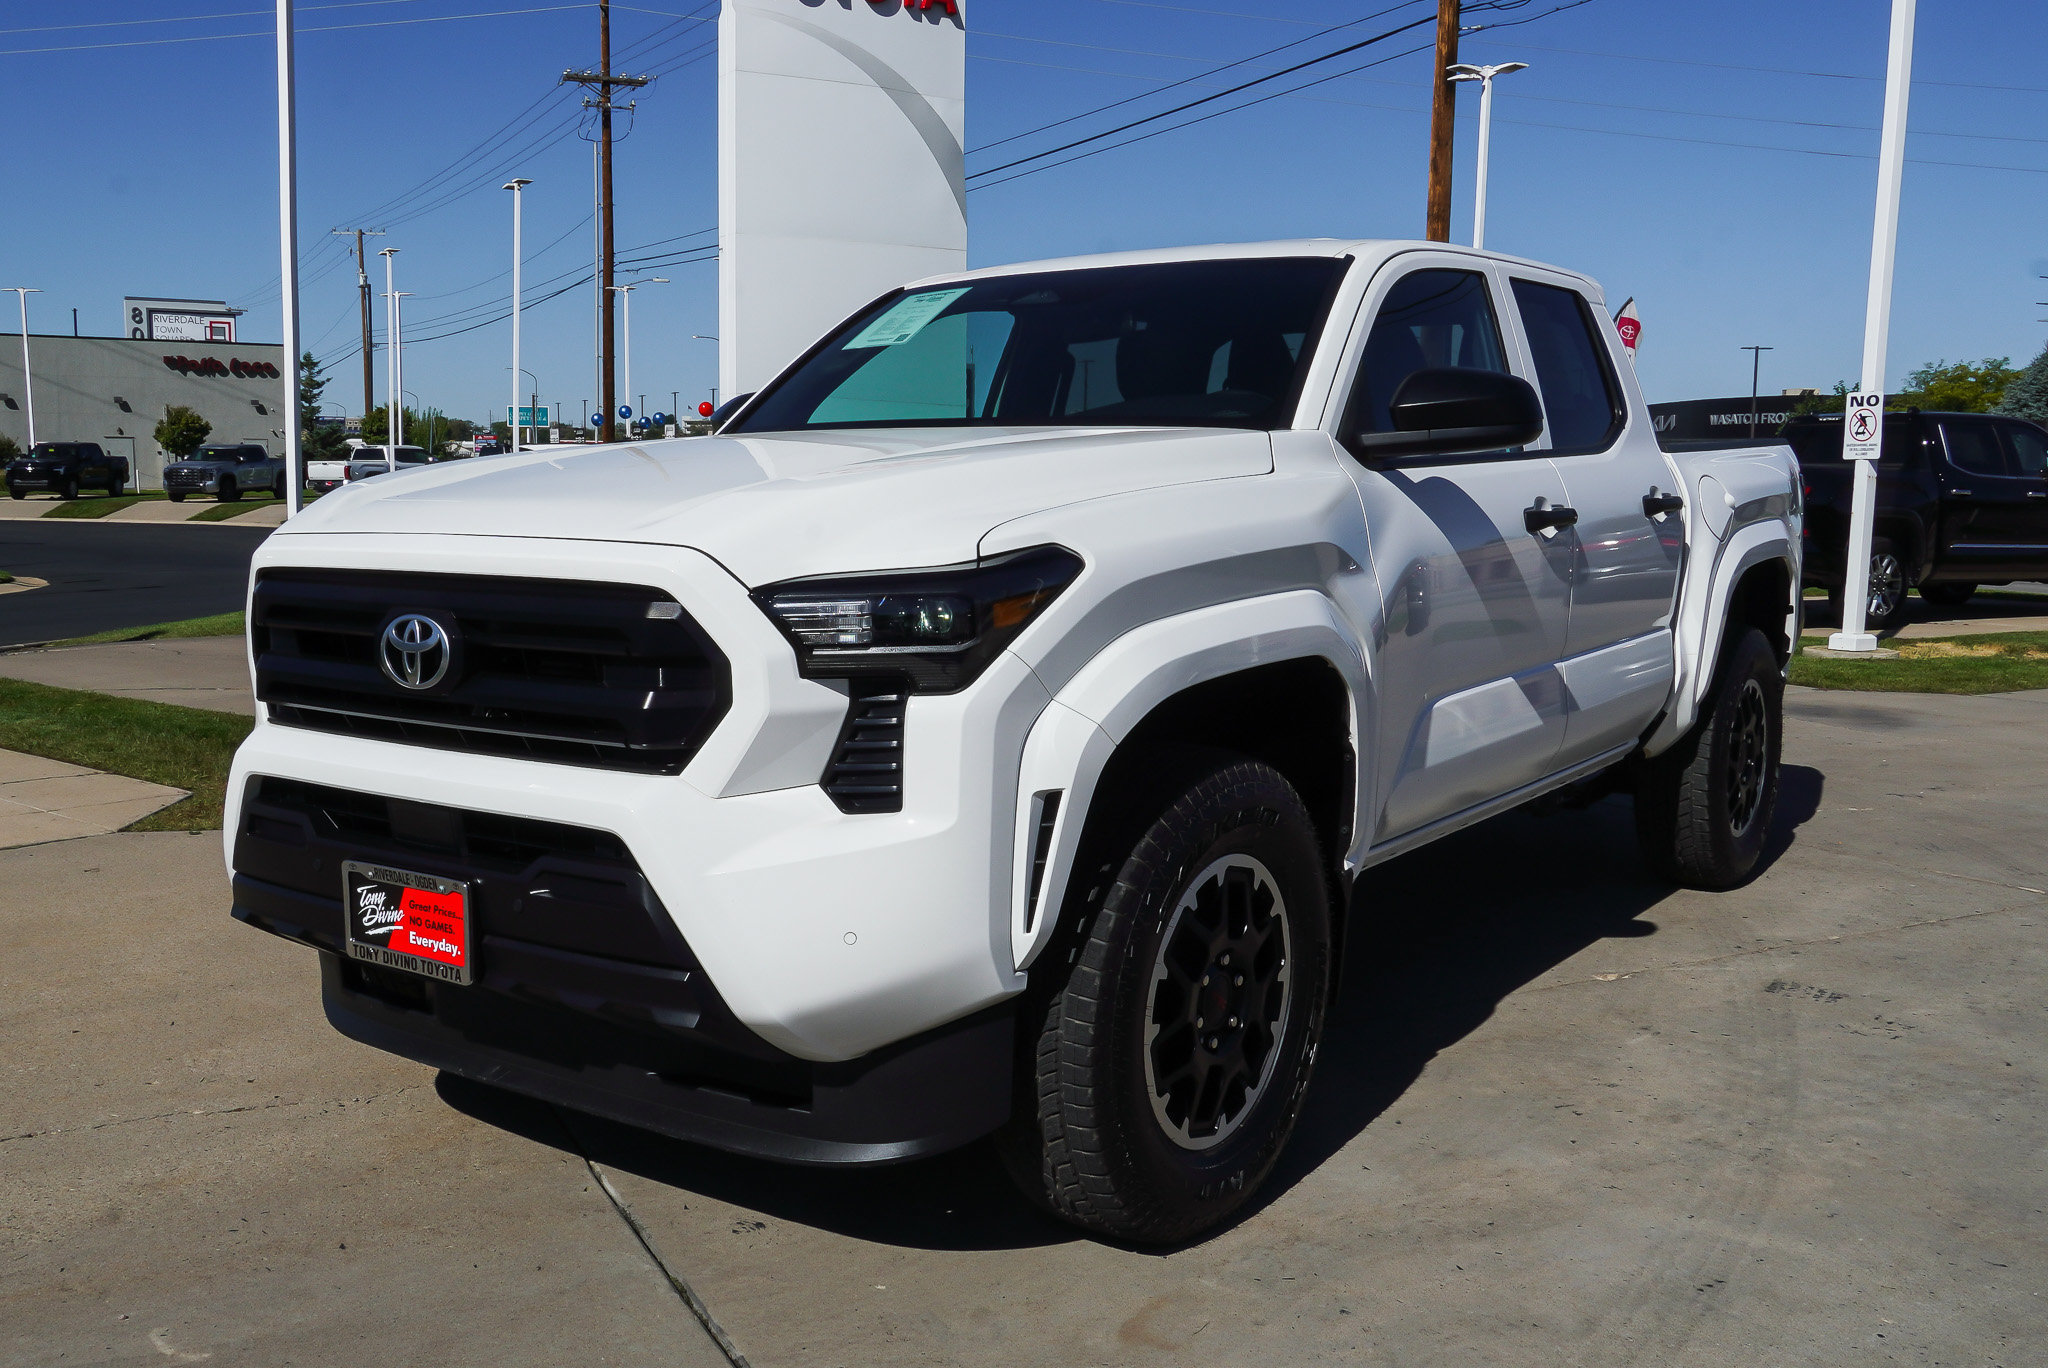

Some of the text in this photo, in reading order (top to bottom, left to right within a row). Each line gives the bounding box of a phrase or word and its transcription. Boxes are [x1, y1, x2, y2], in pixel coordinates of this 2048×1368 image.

[153, 314, 205, 325] RIVERDALE
[154, 325, 183, 334] TOWN
[1850, 394, 1880, 408] NO
[372, 867, 412, 886] RIVERDALE
[414, 875, 438, 891] OGDEN
[357, 884, 387, 912] Tony
[408, 899, 432, 913] Great
[409, 915, 456, 935] NO GAMES.
[409, 930, 461, 957] Everyday.
[352, 943, 463, 983] TONY DIVINO TOYOTA
